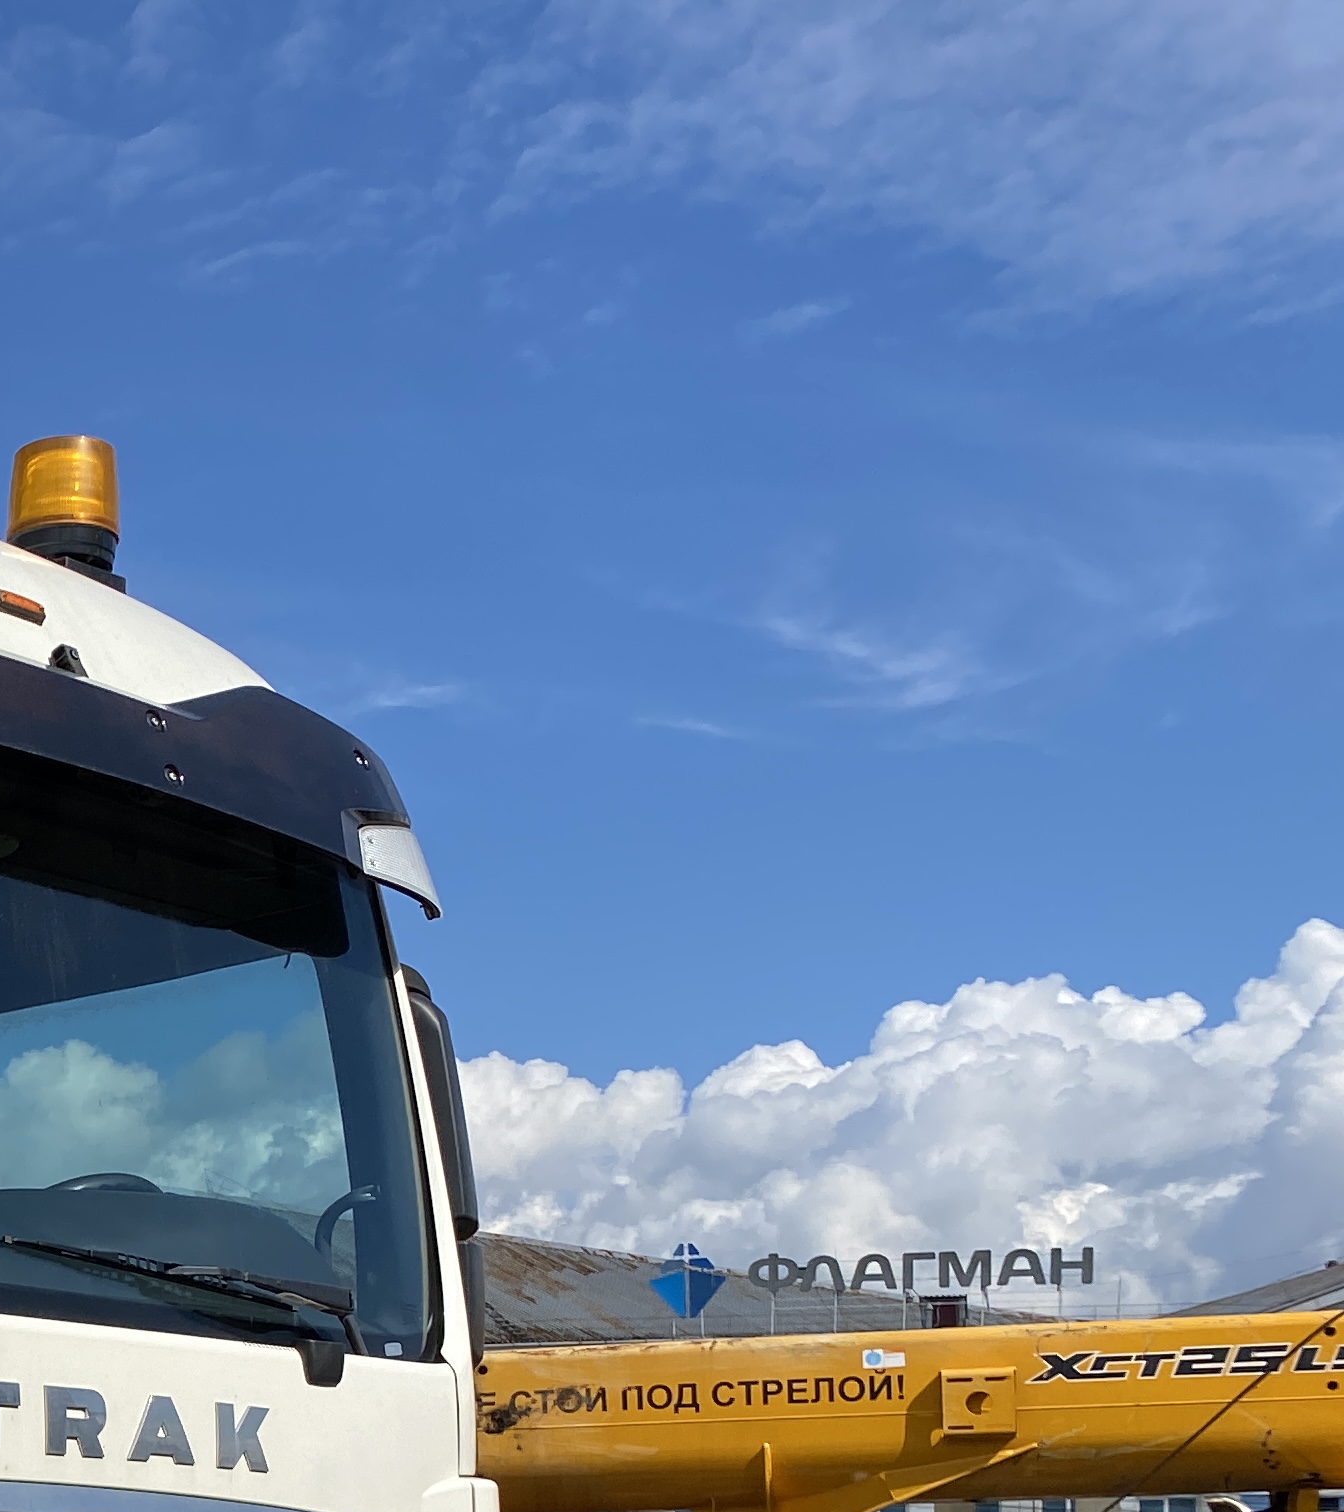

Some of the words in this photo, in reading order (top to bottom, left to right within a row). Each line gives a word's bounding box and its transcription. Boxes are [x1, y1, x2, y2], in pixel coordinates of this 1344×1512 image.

[747, 1246, 1094, 1293] ФЛАГМАН
[621, 1383, 700, 1414] ПОД
[712, 1369, 905, 1407] СТРЕЛОЙ!
